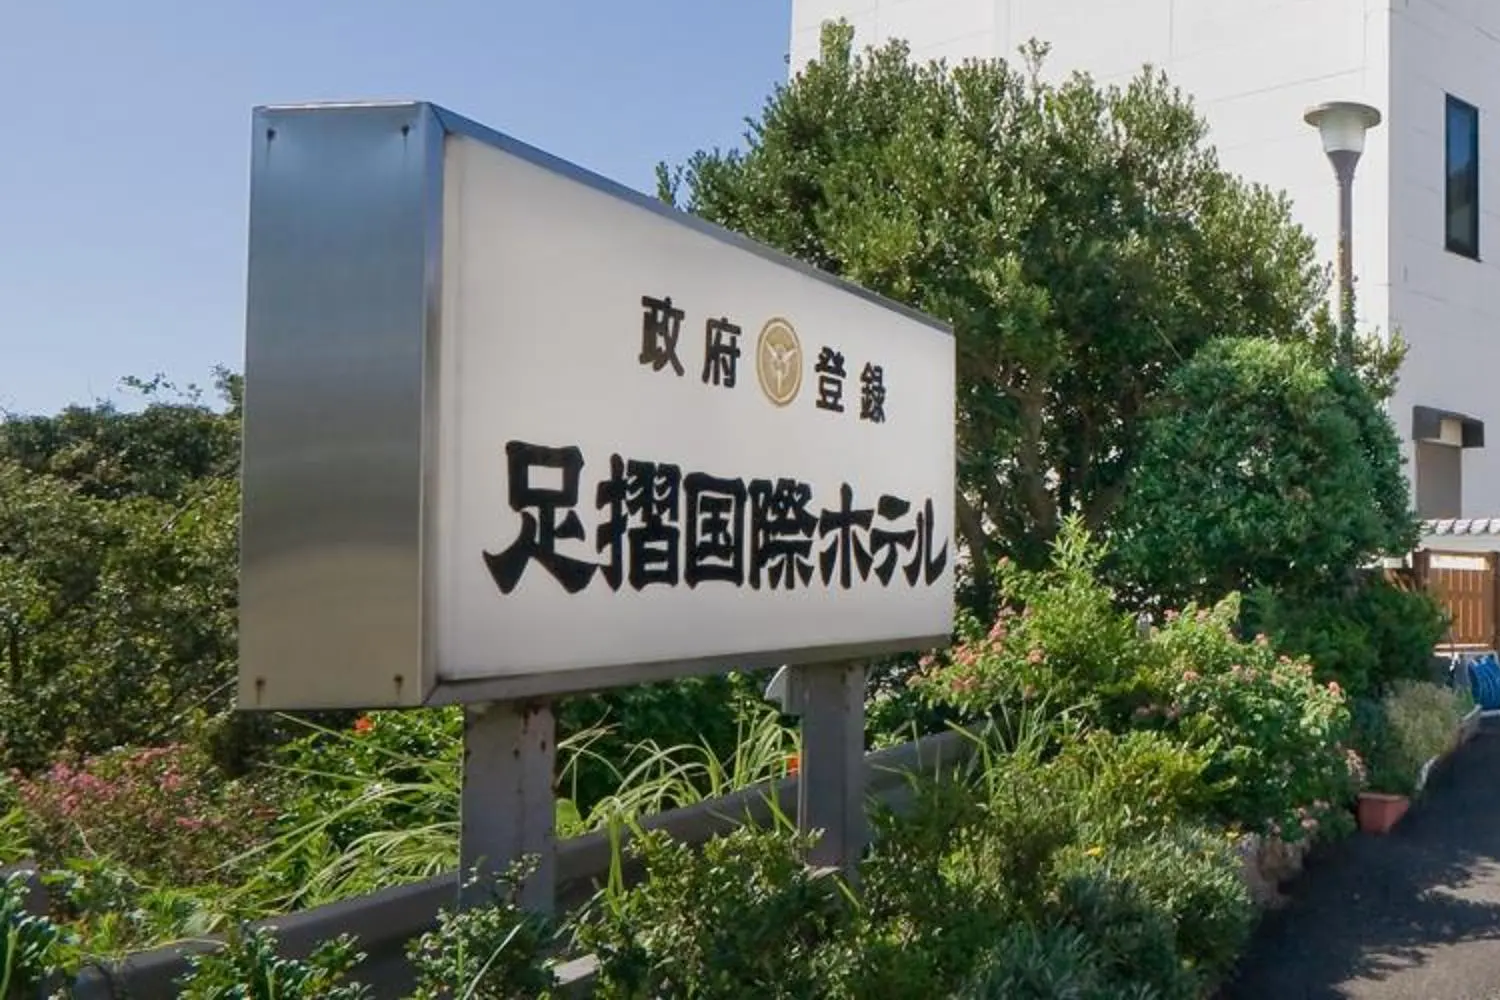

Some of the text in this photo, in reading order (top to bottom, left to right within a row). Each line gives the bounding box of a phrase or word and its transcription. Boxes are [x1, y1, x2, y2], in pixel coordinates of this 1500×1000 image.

[639, 295, 886, 424] 政府 登録
[482, 440, 948, 595] 足摺国際ホテル
